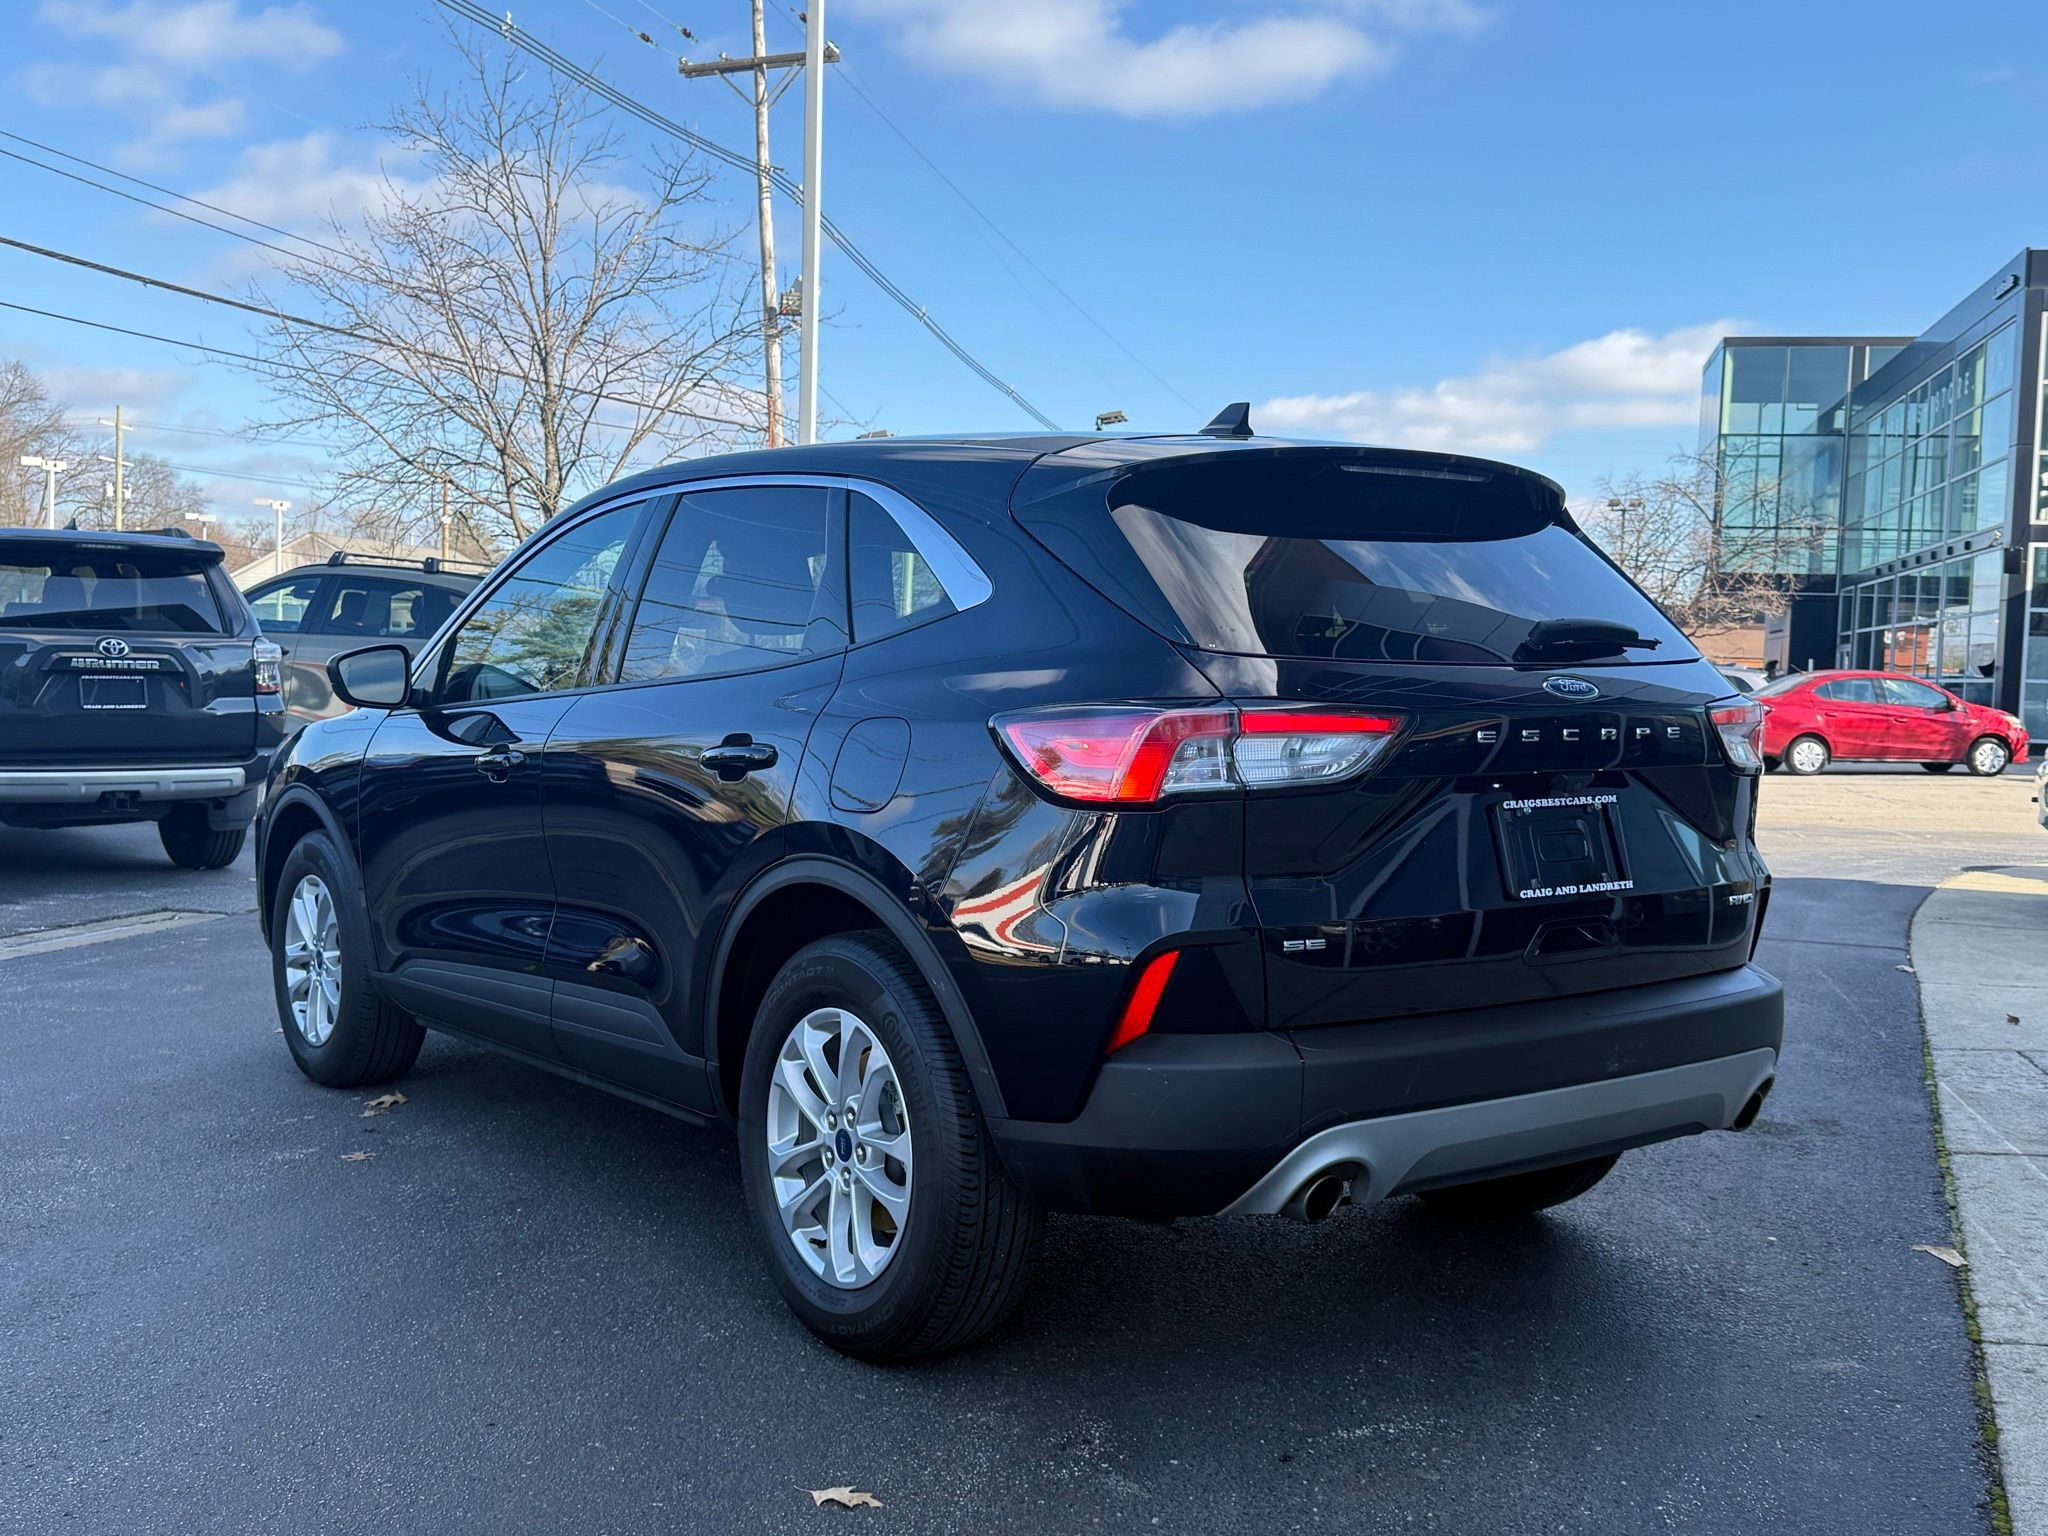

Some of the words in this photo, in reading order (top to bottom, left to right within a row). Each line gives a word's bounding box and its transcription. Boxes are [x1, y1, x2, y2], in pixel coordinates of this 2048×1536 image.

[1557, 679, 1590, 692] Ford
[1476, 726, 1681, 743] ESCAPE
[1503, 794, 1618, 809] CRAIGSBESTCARS.COM
[1520, 888, 1553, 899] CRAIG
[1555, 885, 1578, 896] AND
[1579, 880, 1634, 893] LANDRETH
[1283, 939, 1326, 951] SE
